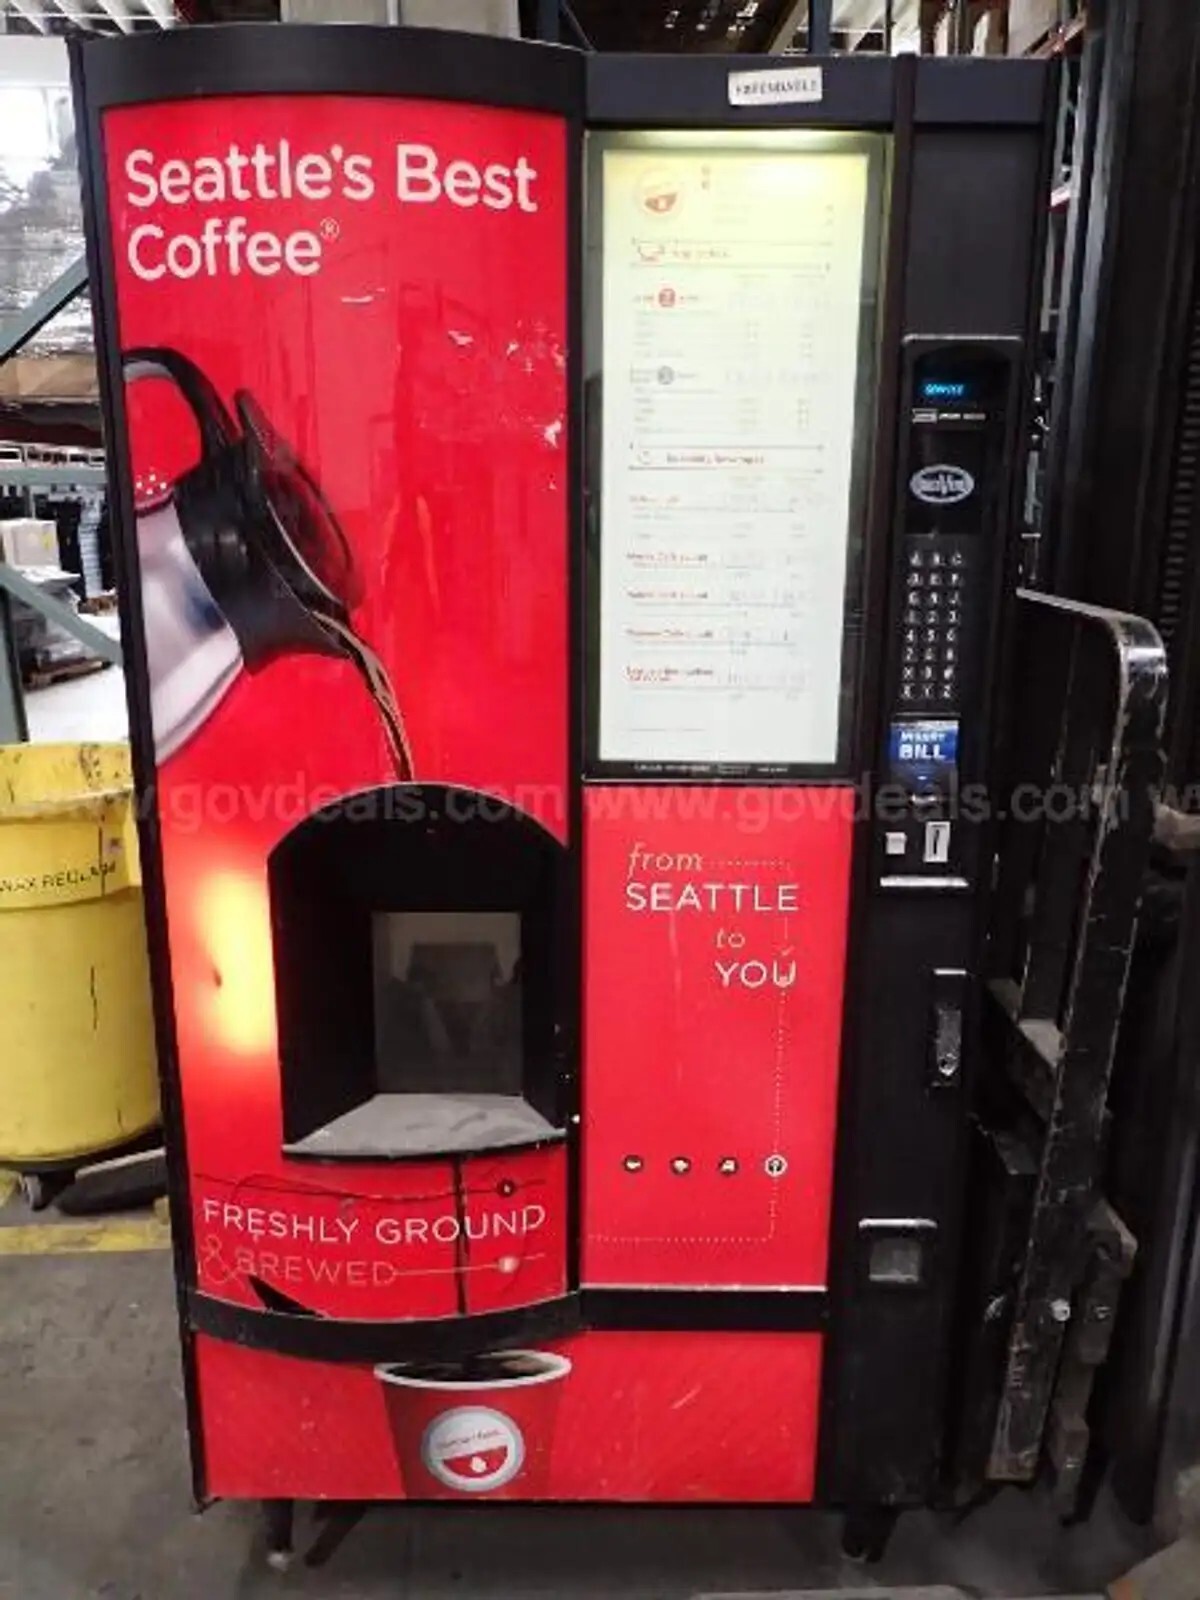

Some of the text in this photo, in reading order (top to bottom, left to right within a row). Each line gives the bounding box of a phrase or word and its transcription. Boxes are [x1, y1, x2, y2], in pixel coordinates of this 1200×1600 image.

[124, 139, 538, 213] Seattle's Best
[898, 743, 947, 760] BILL
[627, 841, 703, 880] from
[625, 881, 800, 913] SEATTLE
[714, 927, 747, 949] to
[714, 960, 798, 990] YOU
[203, 1200, 547, 1245] FRESHLY GROUND
[234, 1245, 397, 1288] BREWED
